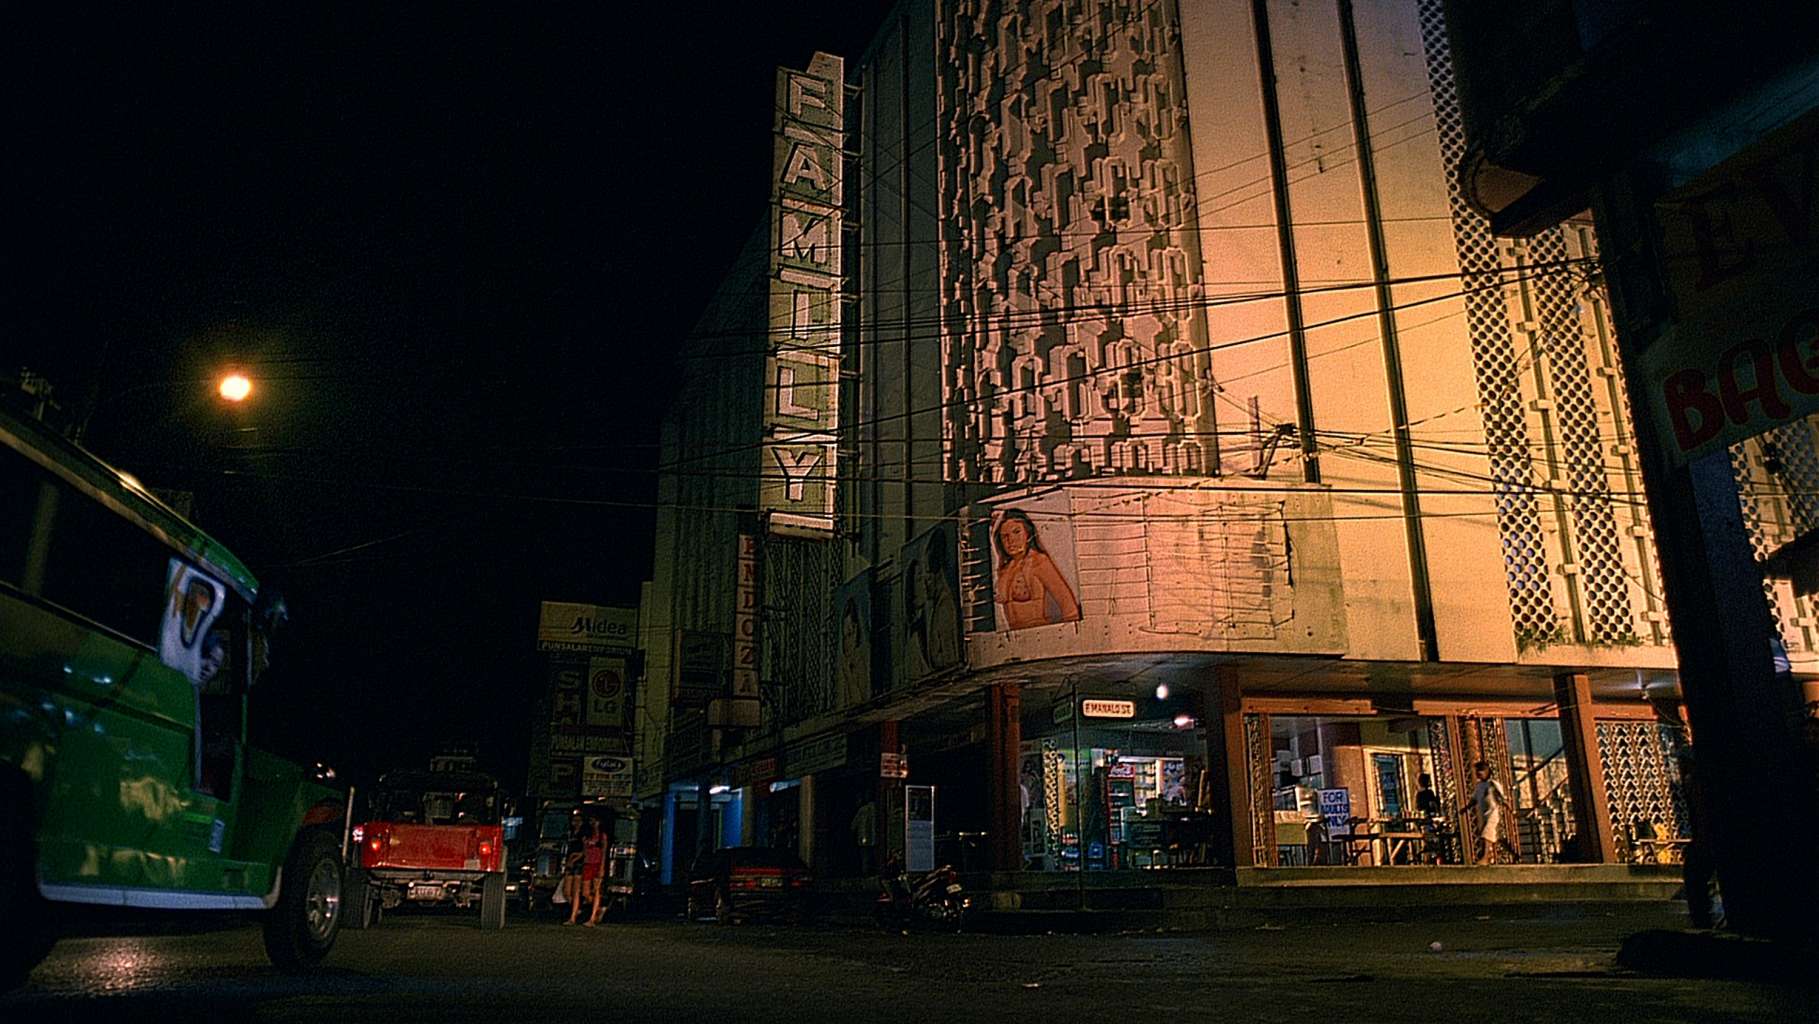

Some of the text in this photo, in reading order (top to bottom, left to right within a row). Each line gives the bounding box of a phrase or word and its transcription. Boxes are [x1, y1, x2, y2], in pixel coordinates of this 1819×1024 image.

[773, 74, 828, 502] FAMILY
[570, 616, 627, 635] Midea
[594, 700, 617, 714] LG
[1322, 791, 1344, 803] FOR
